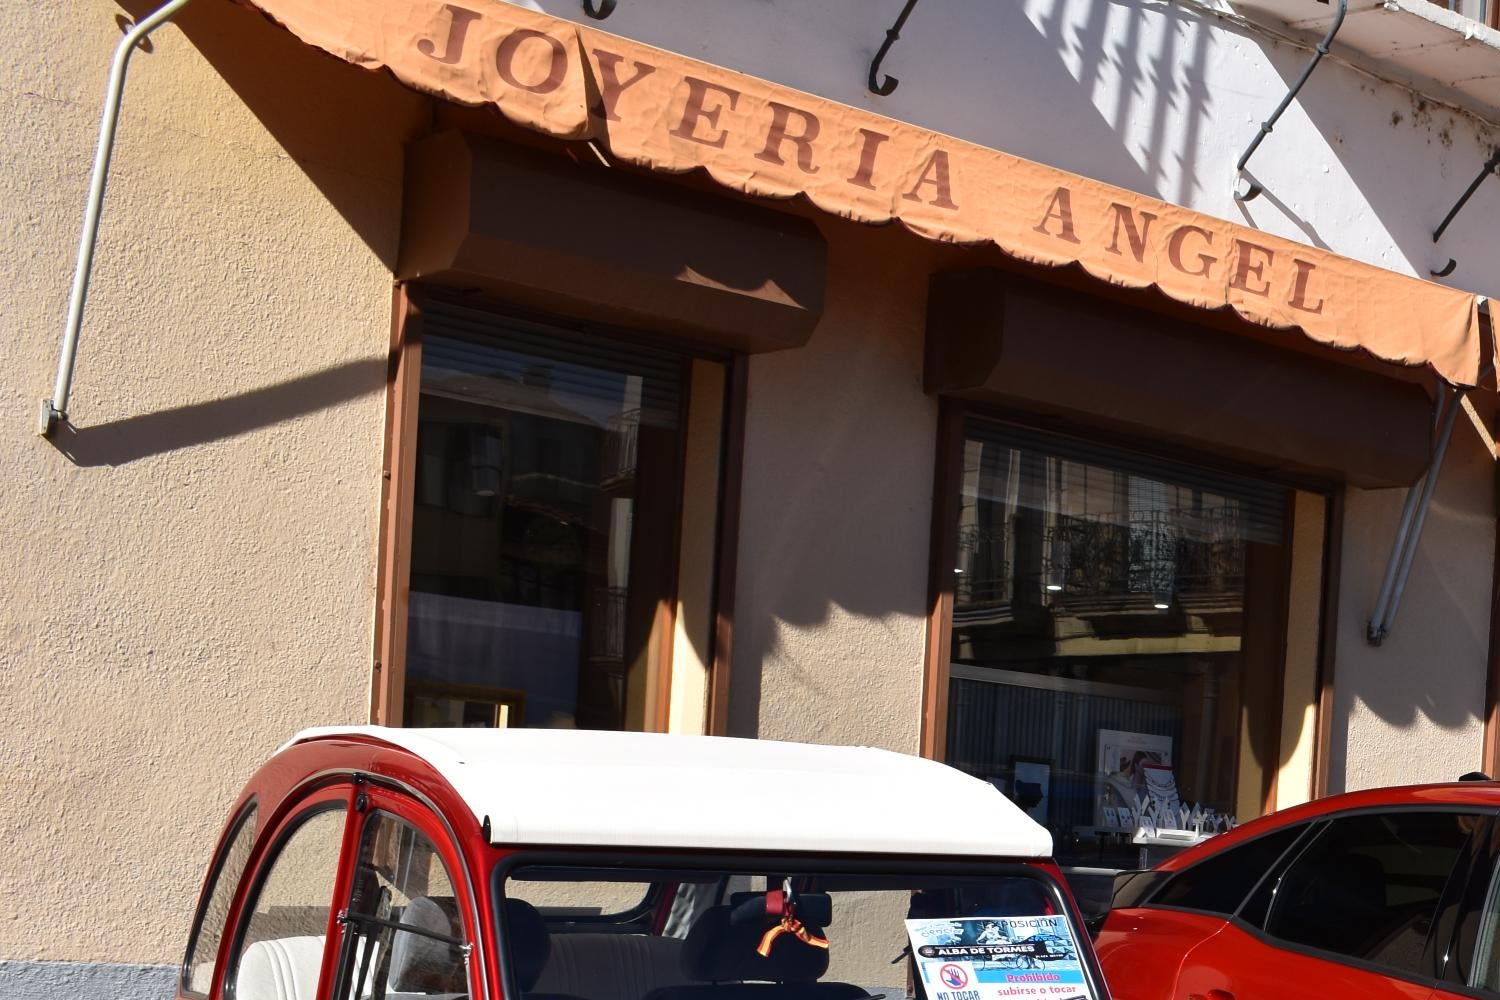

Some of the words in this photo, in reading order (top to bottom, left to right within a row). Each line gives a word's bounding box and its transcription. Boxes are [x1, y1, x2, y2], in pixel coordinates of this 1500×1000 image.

[417, 4, 960, 210] JOYERIA
[1033, 186, 1326, 315] ANGEL
[938, 947, 971, 956] ALBA
[972, 947, 986, 955] DE
[987, 945, 1035, 955] TORMES
[1006, 972, 1061, 982] Prohibido
[997, 986, 1037, 996] subirse
[1049, 985, 1077, 993] tocar
